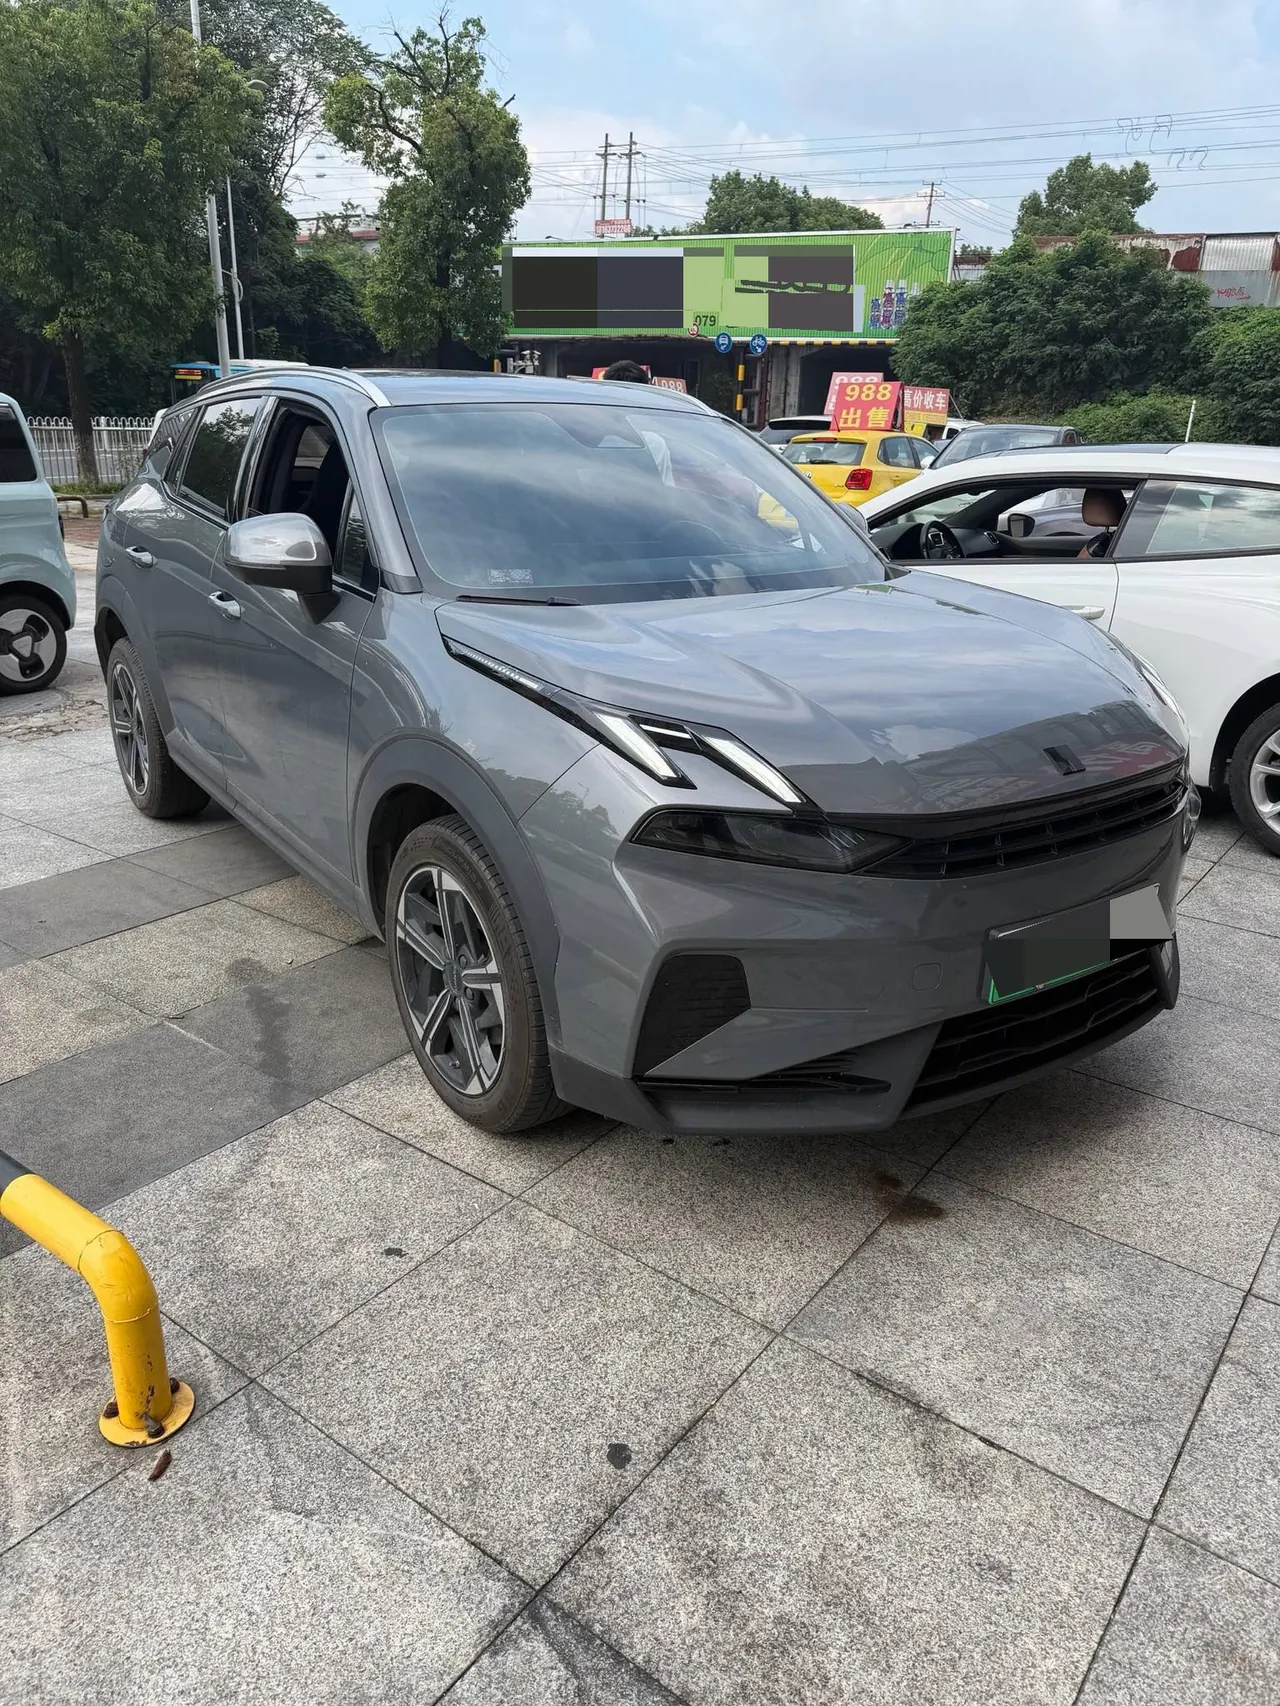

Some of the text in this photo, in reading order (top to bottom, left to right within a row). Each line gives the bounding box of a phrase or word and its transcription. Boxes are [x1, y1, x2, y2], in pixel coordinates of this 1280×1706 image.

[694, 314, 717, 327] 079
[844, 383, 893, 401] 988
[903, 388, 947, 410] 高价收车
[839, 406, 891, 428] 出售
